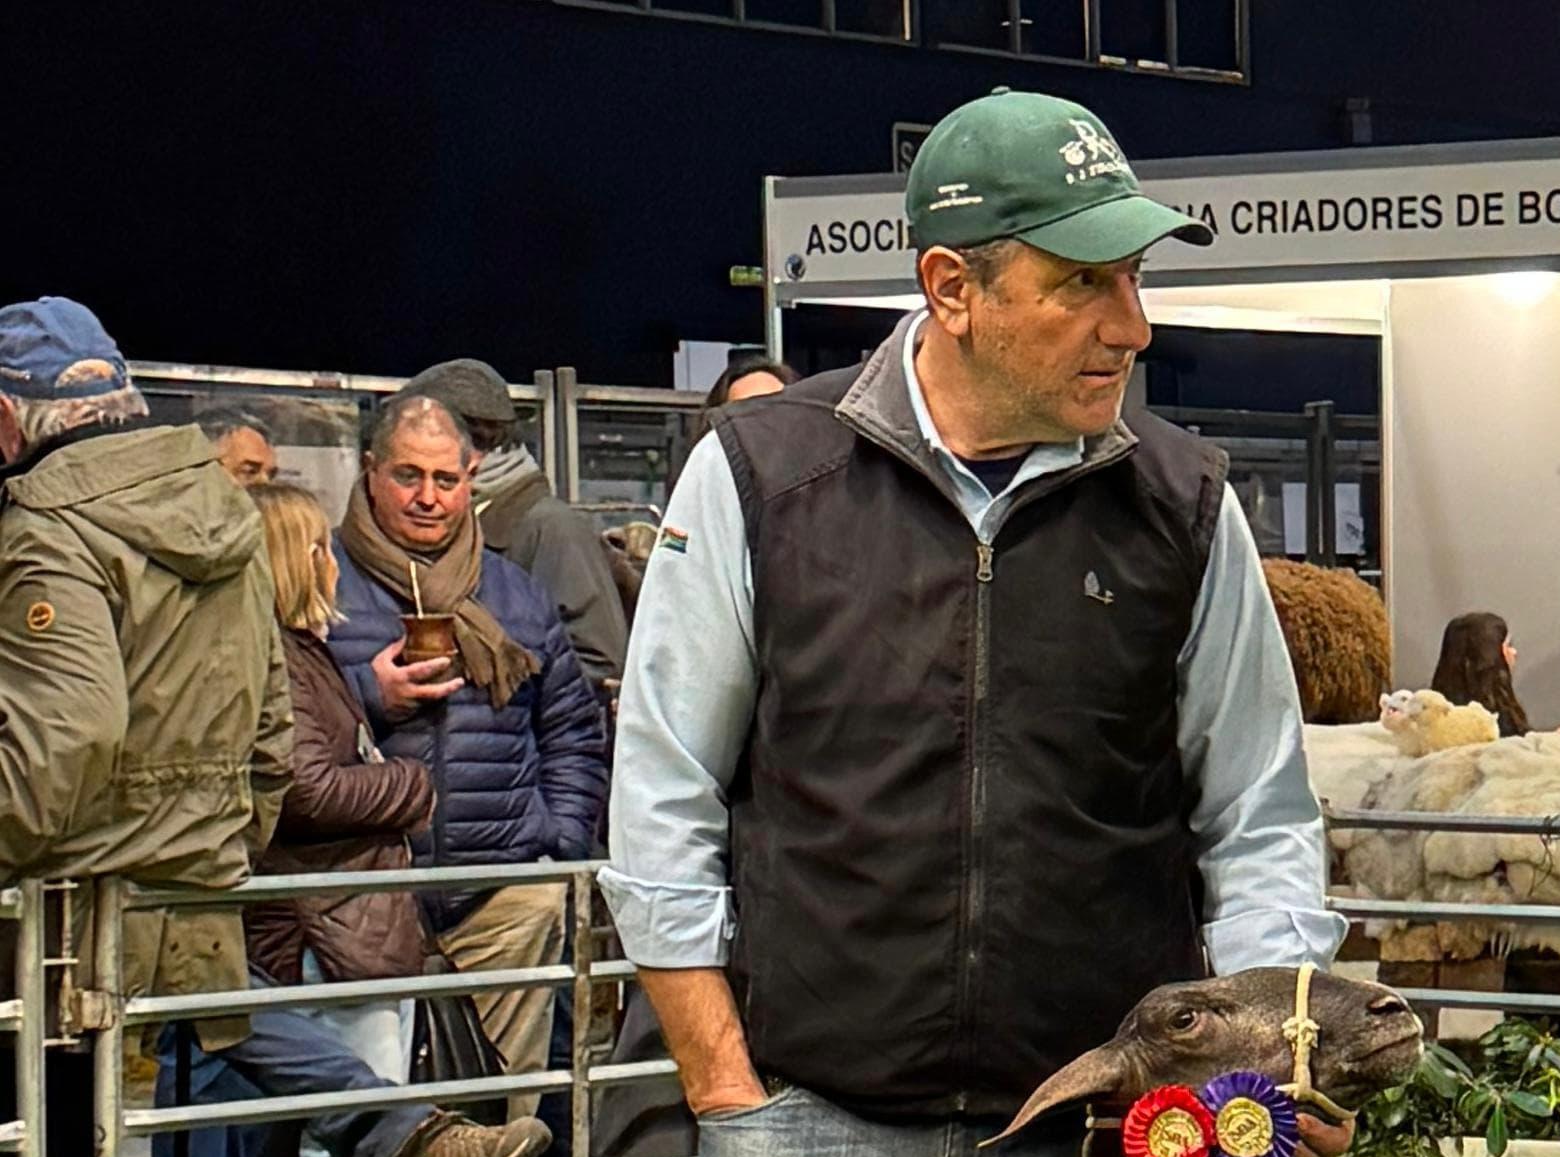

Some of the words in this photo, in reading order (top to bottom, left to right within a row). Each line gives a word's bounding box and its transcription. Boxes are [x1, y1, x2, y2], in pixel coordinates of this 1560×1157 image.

[806, 218, 914, 257] ASOCI
[1231, 197, 1442, 235] CRIADORES
[1451, 194, 1504, 228] DE
